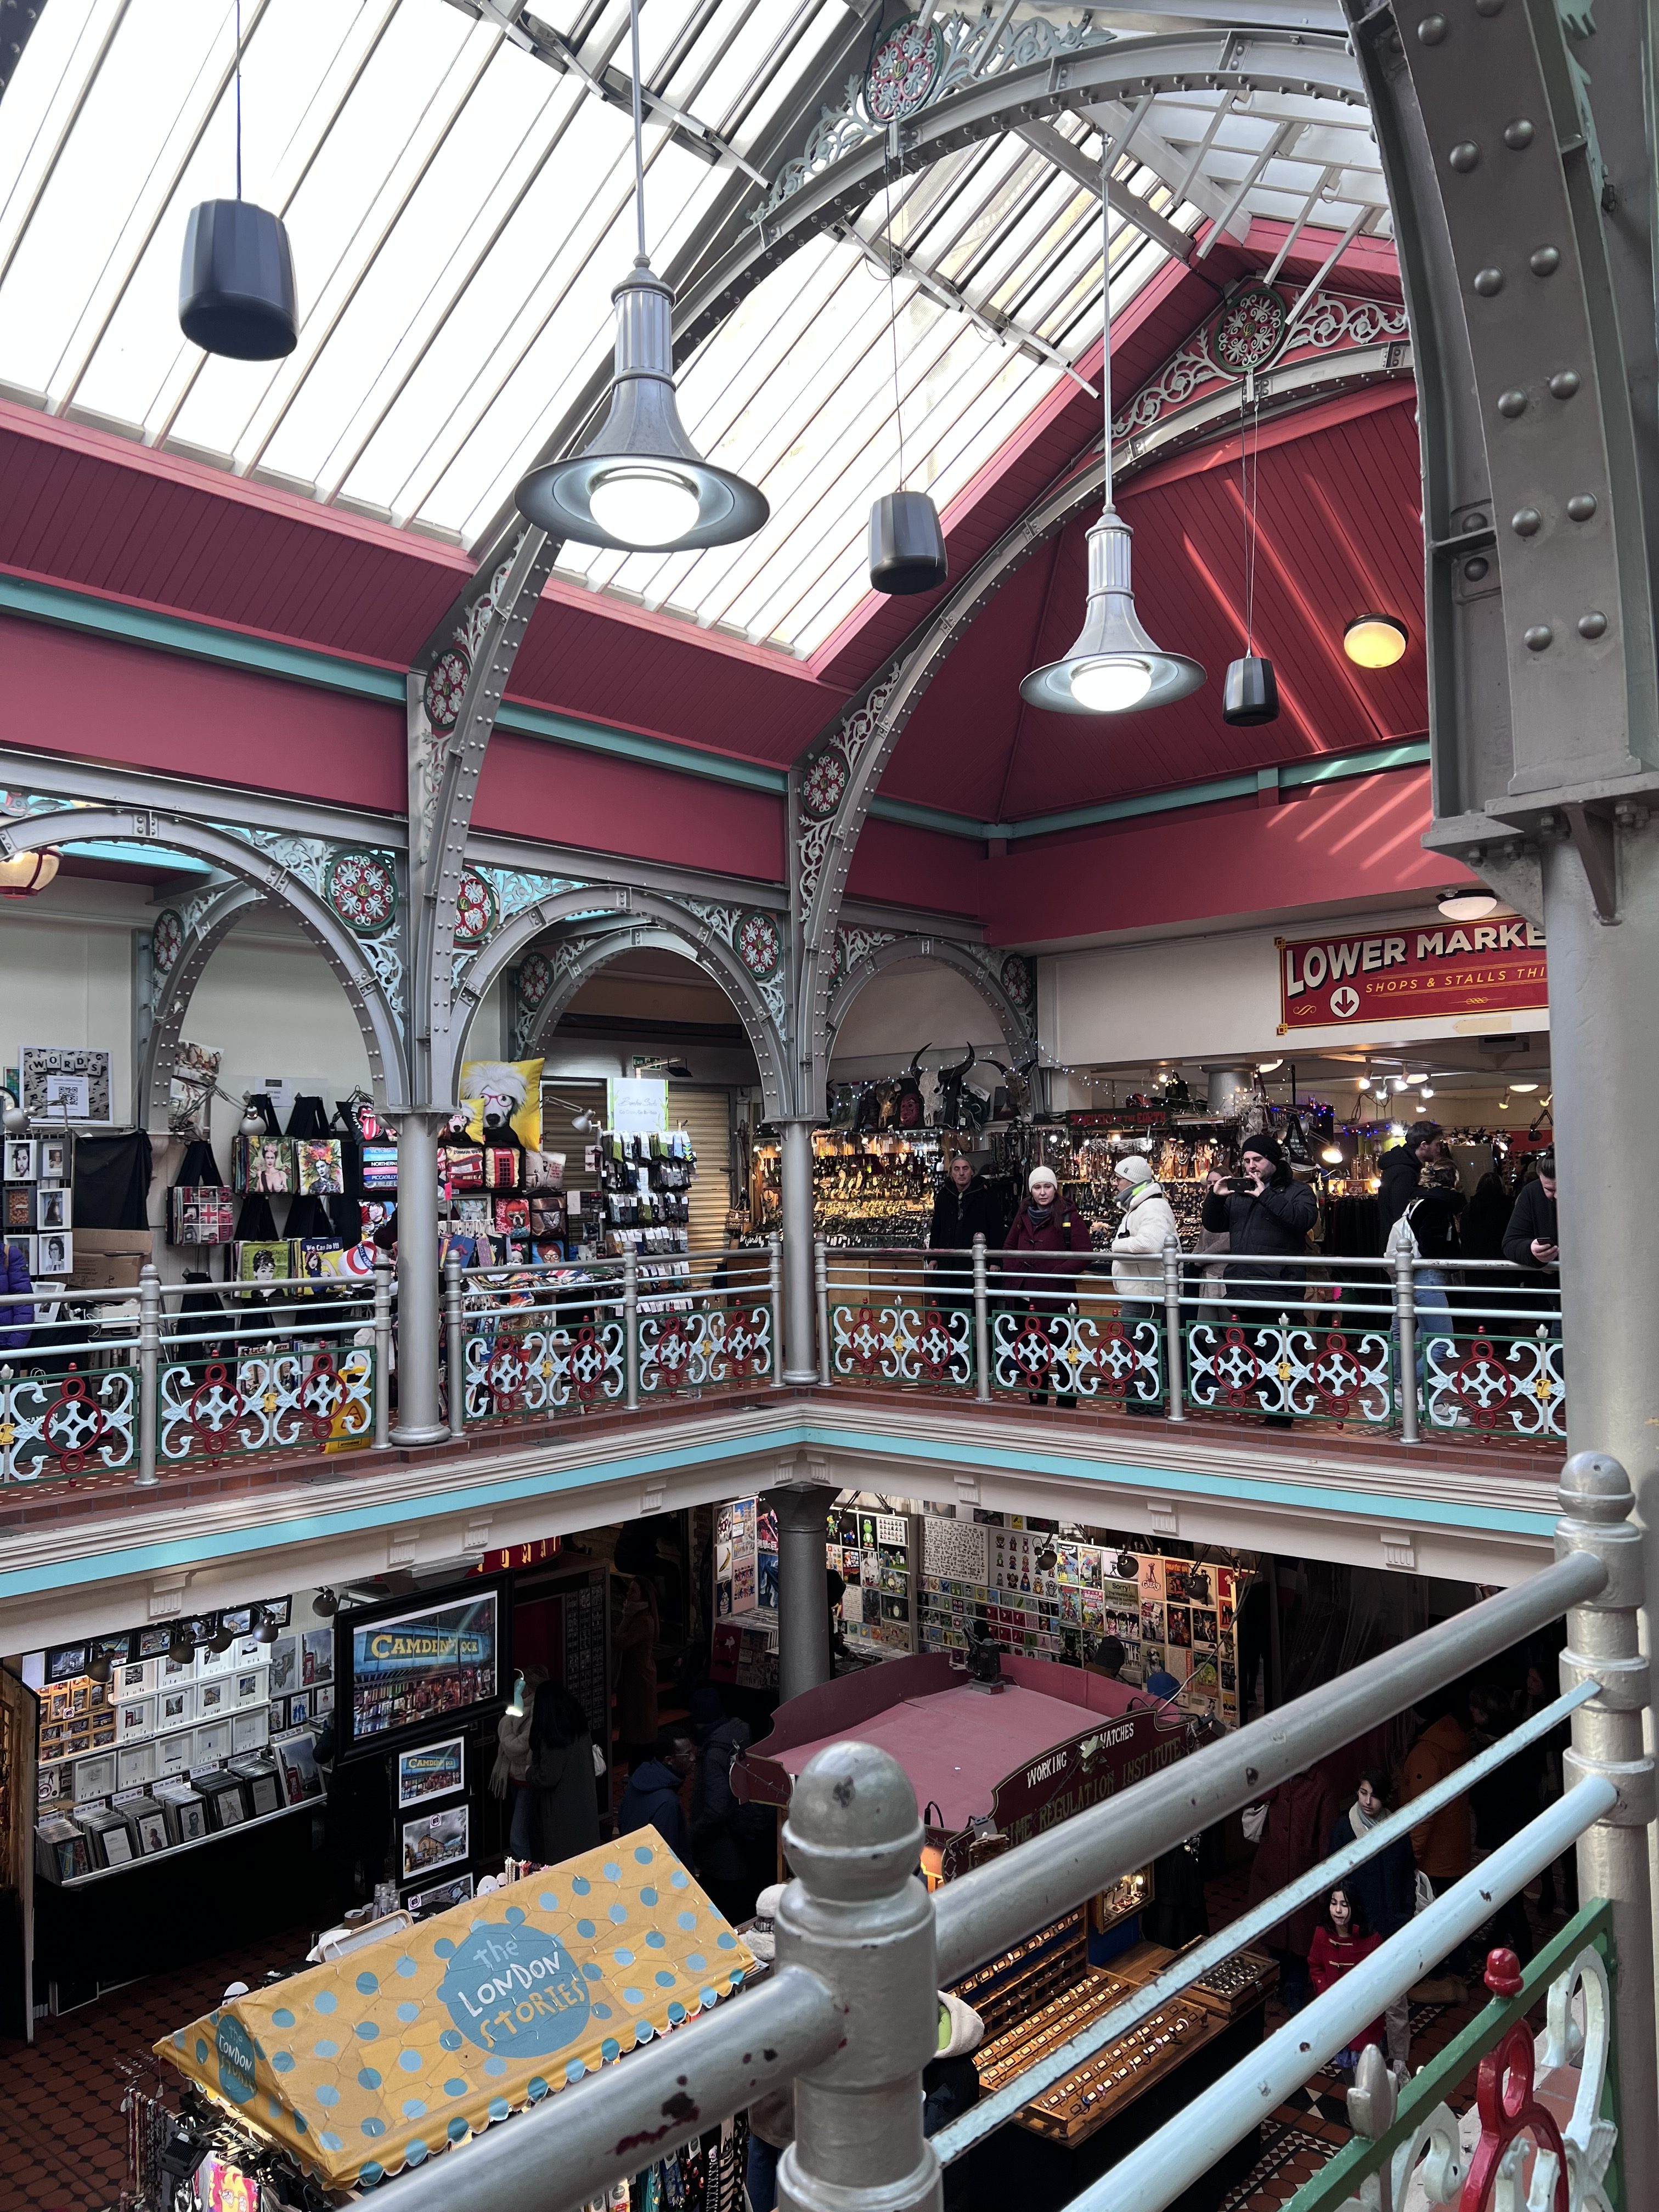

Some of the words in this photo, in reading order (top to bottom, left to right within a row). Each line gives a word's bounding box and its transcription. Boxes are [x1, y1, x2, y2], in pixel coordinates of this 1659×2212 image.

[1286, 937, 1407, 997] LOWER
[1417, 922, 1547, 959] MARKE
[1365, 979, 1418, 993] SHOPS
[1427, 978, 1435, 987] &
[1444, 970, 1506, 985] STALLS
[1517, 966, 1544, 979] THI
[33, 1057, 98, 1071] WORDS
[1137, 1111, 1167, 1124] EARTH
[1112, 1582, 1130, 1592] Sorry!
[1142, 1580, 1161, 1591] GREASE
[371, 1635, 449, 1658] CAMDEN
[1124, 1643, 1141, 1654] LIFE
[409, 1758, 440, 1768] CAMDEN
[1027, 1751, 1067, 1788] WORKING
[1039, 1770, 1115, 1831] REGULATION
[1122, 1736, 1181, 1787] INSTITUTE
[473, 1940, 519, 1968] the
[458, 1951, 560, 2017] LONDON
[480, 1978, 585, 2047] STORIES
[219, 2034, 252, 2071] LONDON
